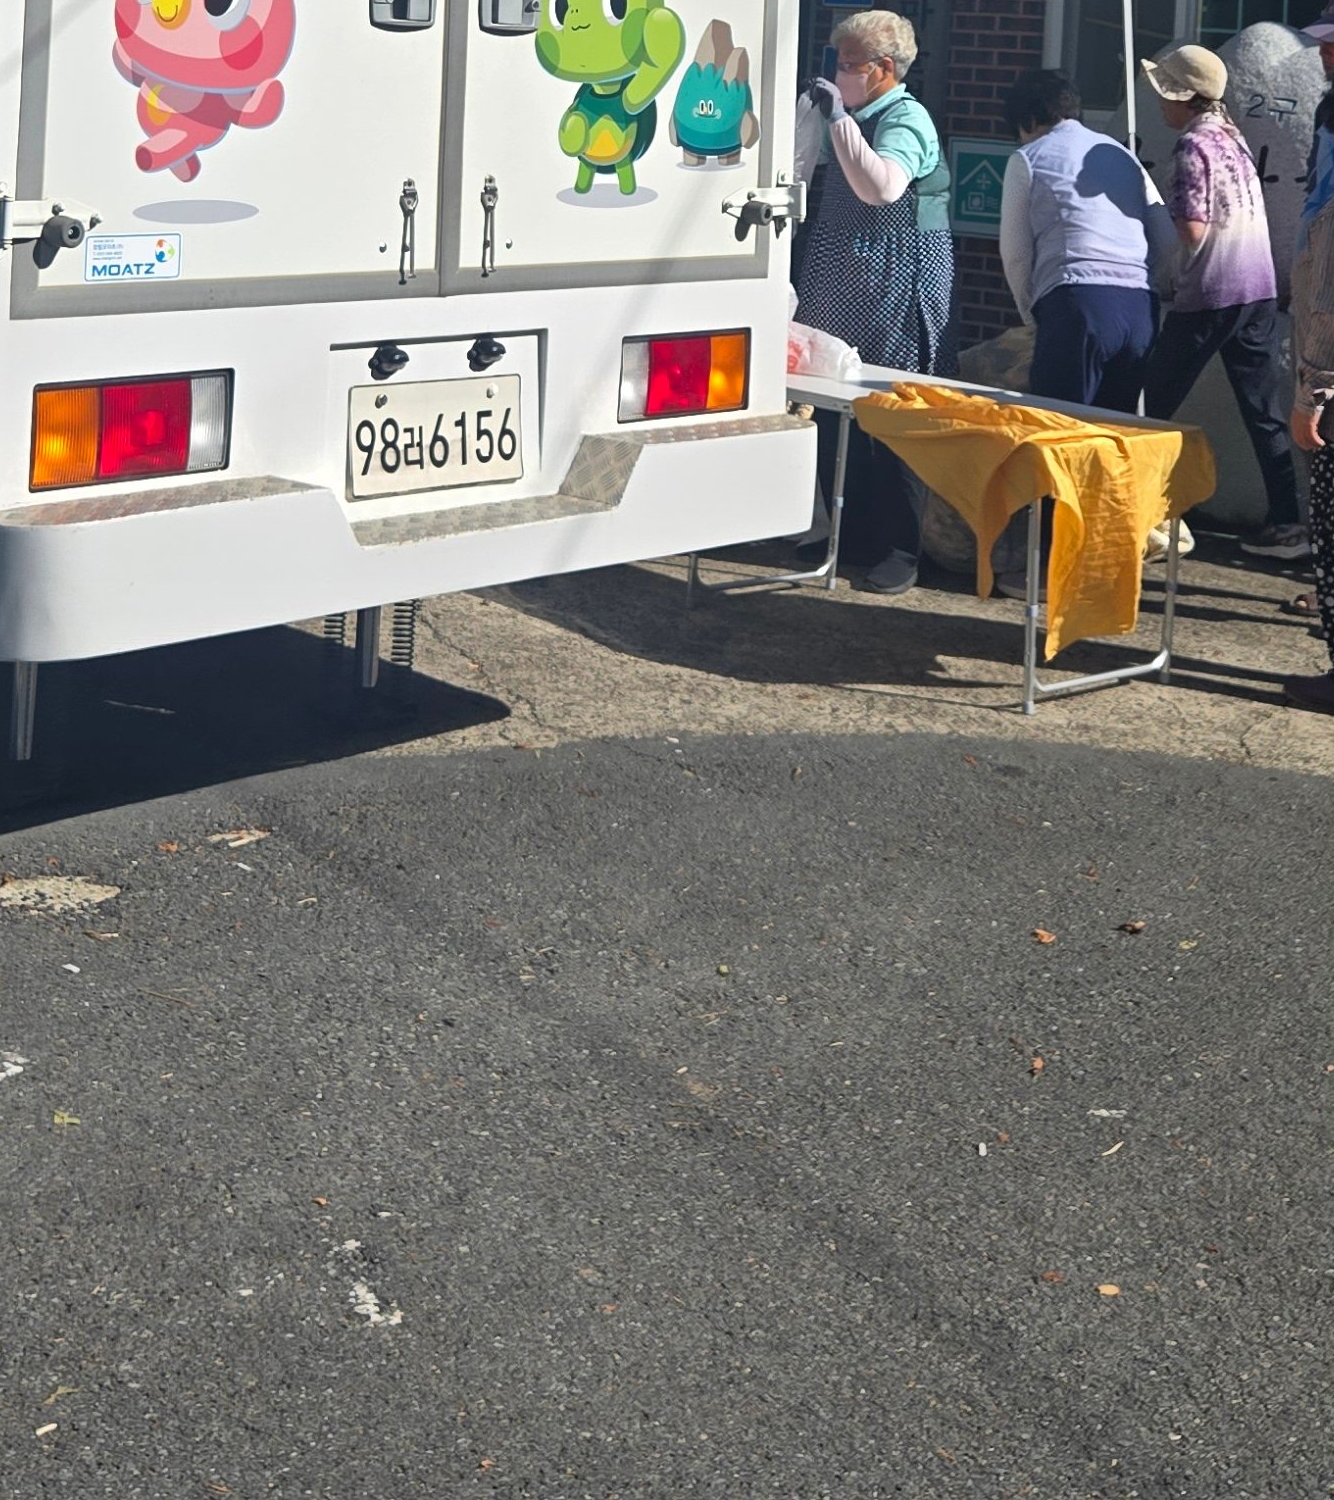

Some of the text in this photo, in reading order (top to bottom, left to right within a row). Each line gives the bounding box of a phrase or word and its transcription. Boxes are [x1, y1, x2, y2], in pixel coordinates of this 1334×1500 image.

[369, 30, 416, 65] GAM-GUN
[1247, 93, 1297, 125] 2구
[92, 263, 155, 276] MOATZ
[356, 408, 517, 476] 98러6156
